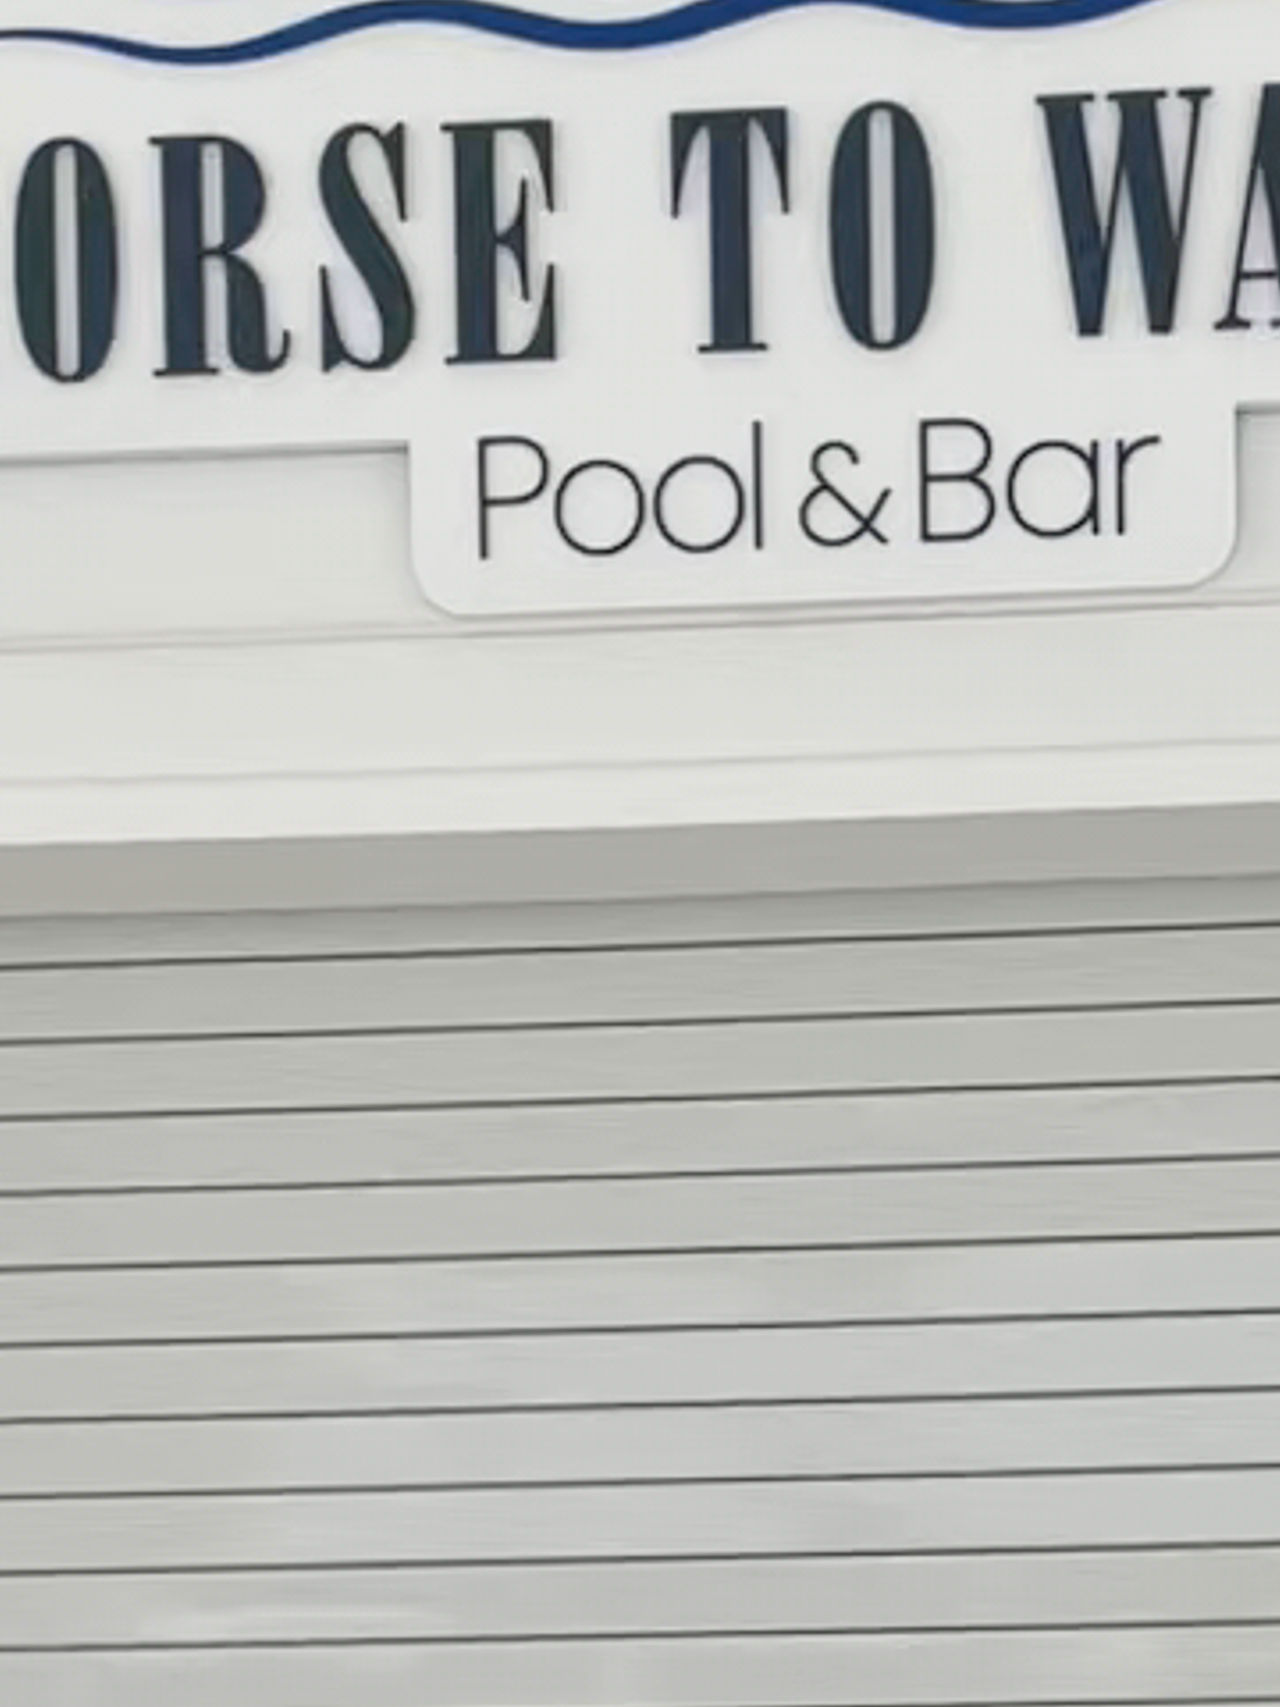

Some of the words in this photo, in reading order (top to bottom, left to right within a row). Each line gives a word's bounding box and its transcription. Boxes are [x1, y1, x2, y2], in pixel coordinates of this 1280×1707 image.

[668, 99, 937, 355] TO
[476, 420, 765, 561] Pool
[917, 416, 1162, 544] Bar
